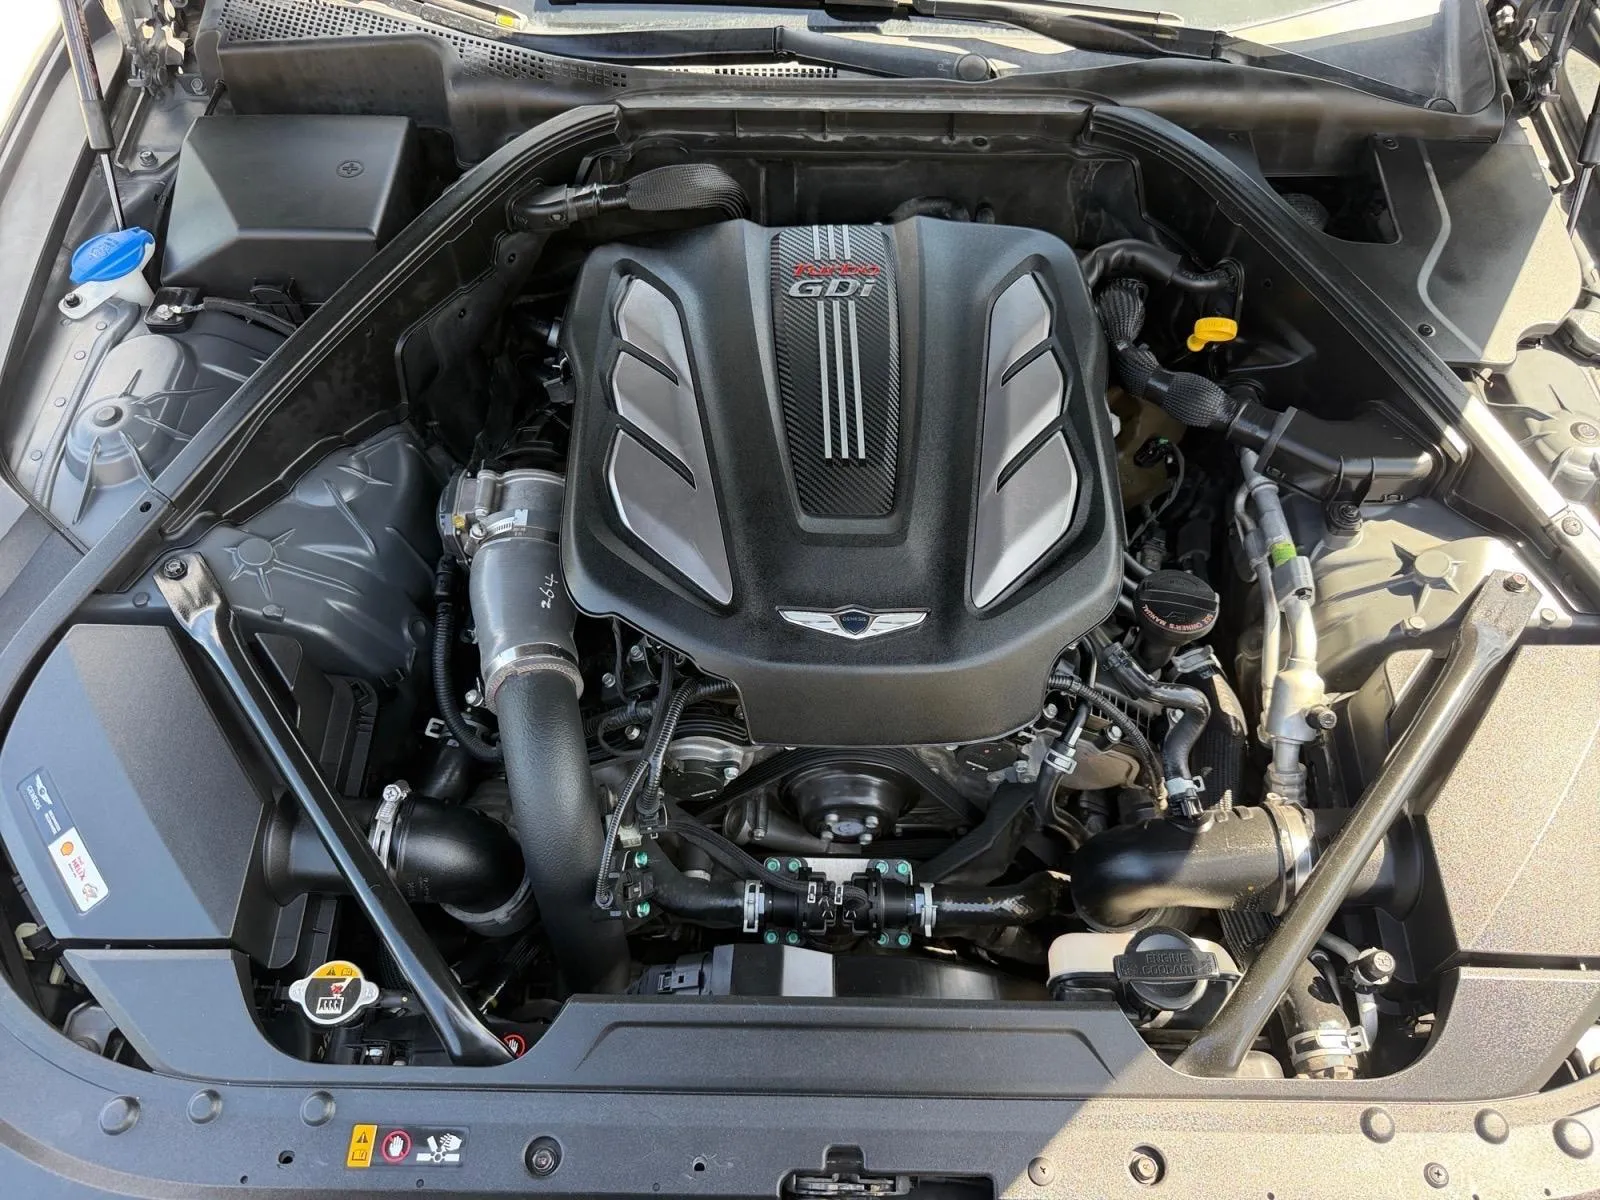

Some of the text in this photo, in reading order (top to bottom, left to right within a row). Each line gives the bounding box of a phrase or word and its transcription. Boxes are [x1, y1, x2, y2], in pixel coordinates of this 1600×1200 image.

[792, 263, 880, 277] Turbo
[788, 279, 877, 298] GDi
[539, 573, 558, 609] 264
[1141, 603, 1167, 626] MANUAL
[26, 785, 42, 810] GENESIS
[71, 858, 86, 881] HELIX
[1145, 952, 1189, 963] ENGINE
[1142, 964, 1195, 975] COOLANT
